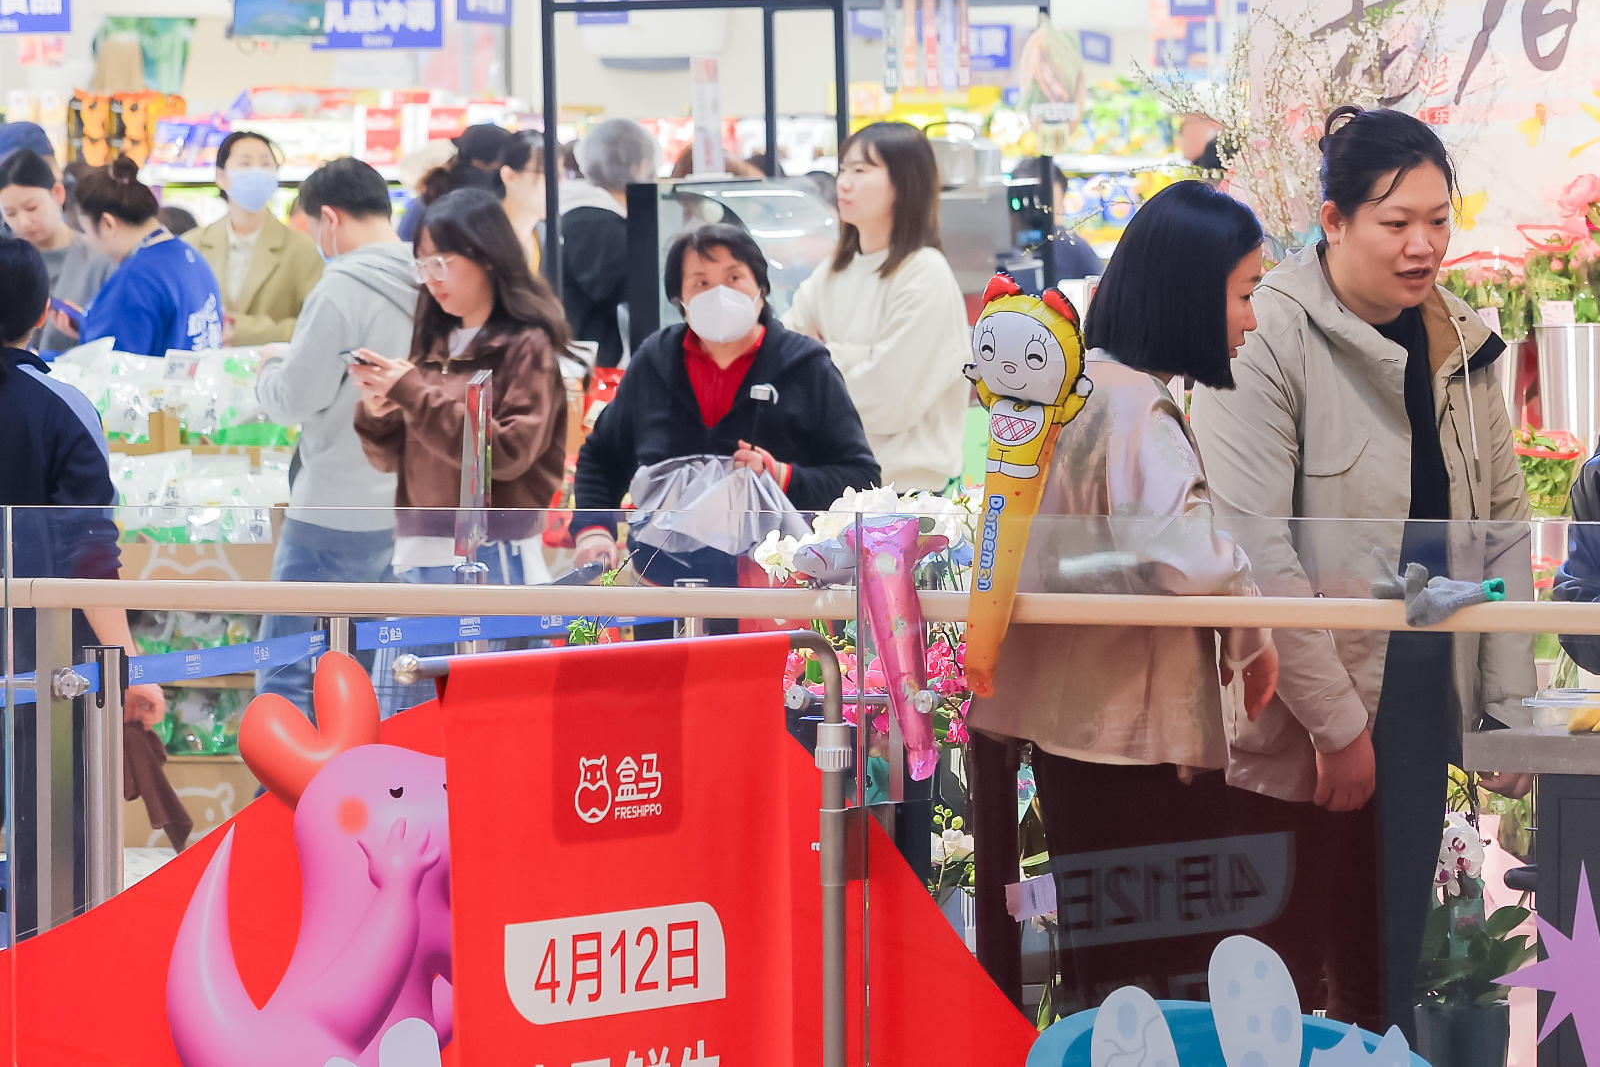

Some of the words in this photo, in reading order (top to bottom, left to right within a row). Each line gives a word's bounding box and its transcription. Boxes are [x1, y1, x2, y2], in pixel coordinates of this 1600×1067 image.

[977, 494, 1005, 591] Doraemon
[614, 753, 663, 802] 盒马
[614, 803, 662, 820] FRESHIPPO
[534, 919, 699, 1008] 4月12日
